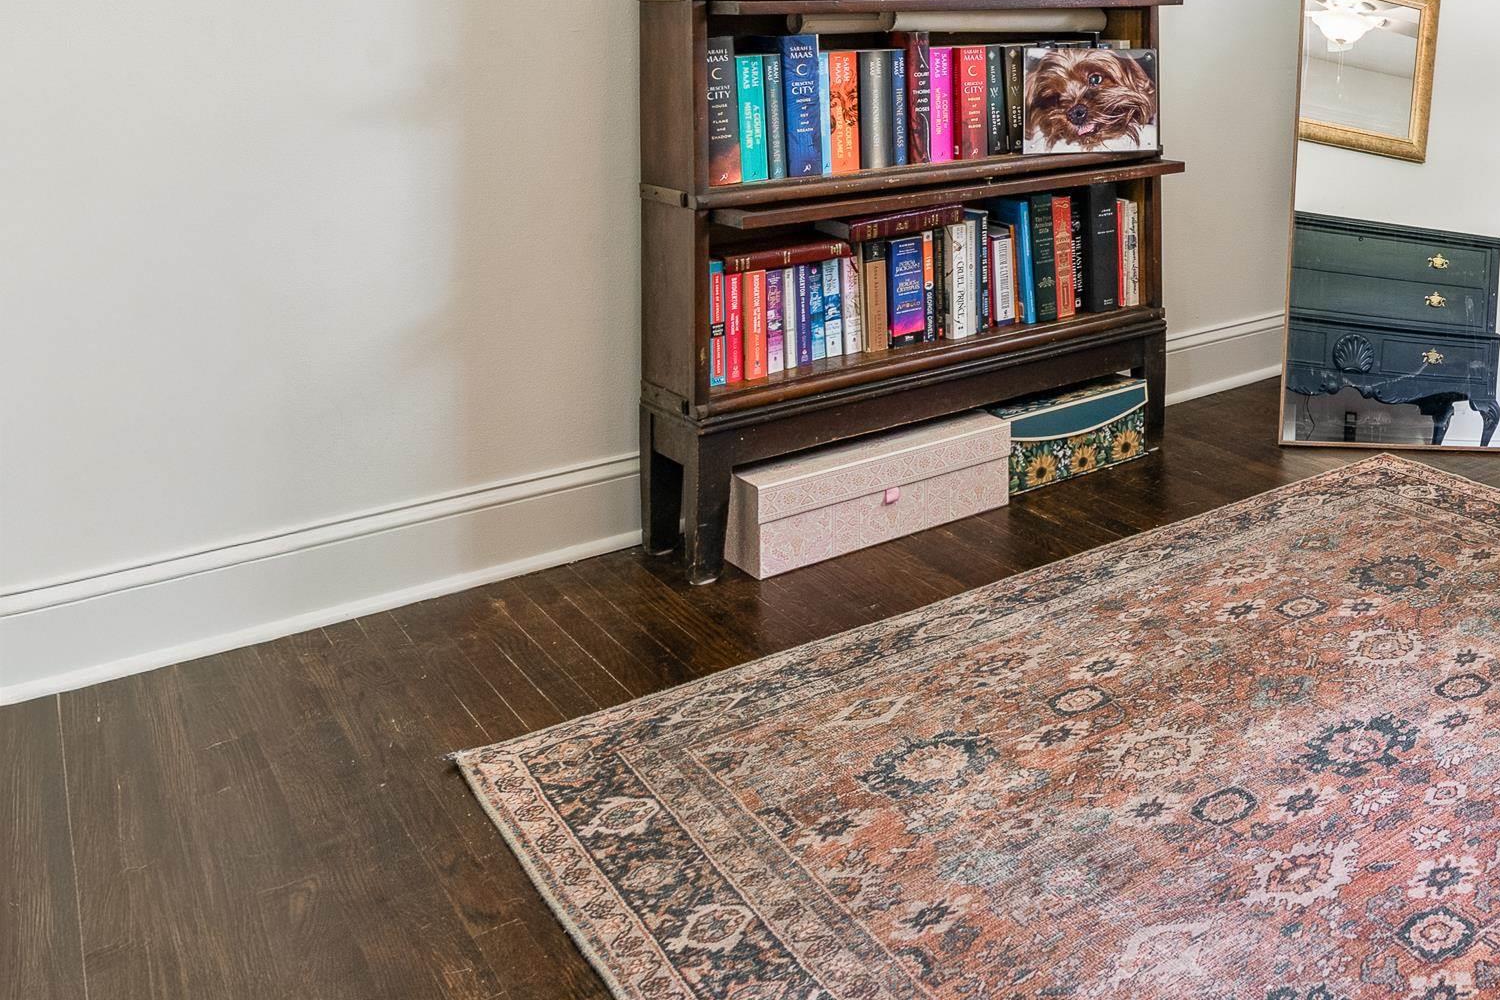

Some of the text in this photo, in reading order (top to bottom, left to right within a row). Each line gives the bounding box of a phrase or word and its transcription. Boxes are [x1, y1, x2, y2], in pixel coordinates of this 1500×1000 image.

[790, 51, 813, 59] MAAS
[751, 62, 759, 86] SARAH
[707, 91, 731, 100] CITY
[792, 86, 815, 95] CITY
[753, 112, 761, 137] COURT
[745, 130, 753, 149] FURY
[773, 141, 781, 163] BLADE
[999, 241, 1010, 309] CATECHISM CATHOLIC CHURCH
[957, 290, 965, 319] PRINCE
